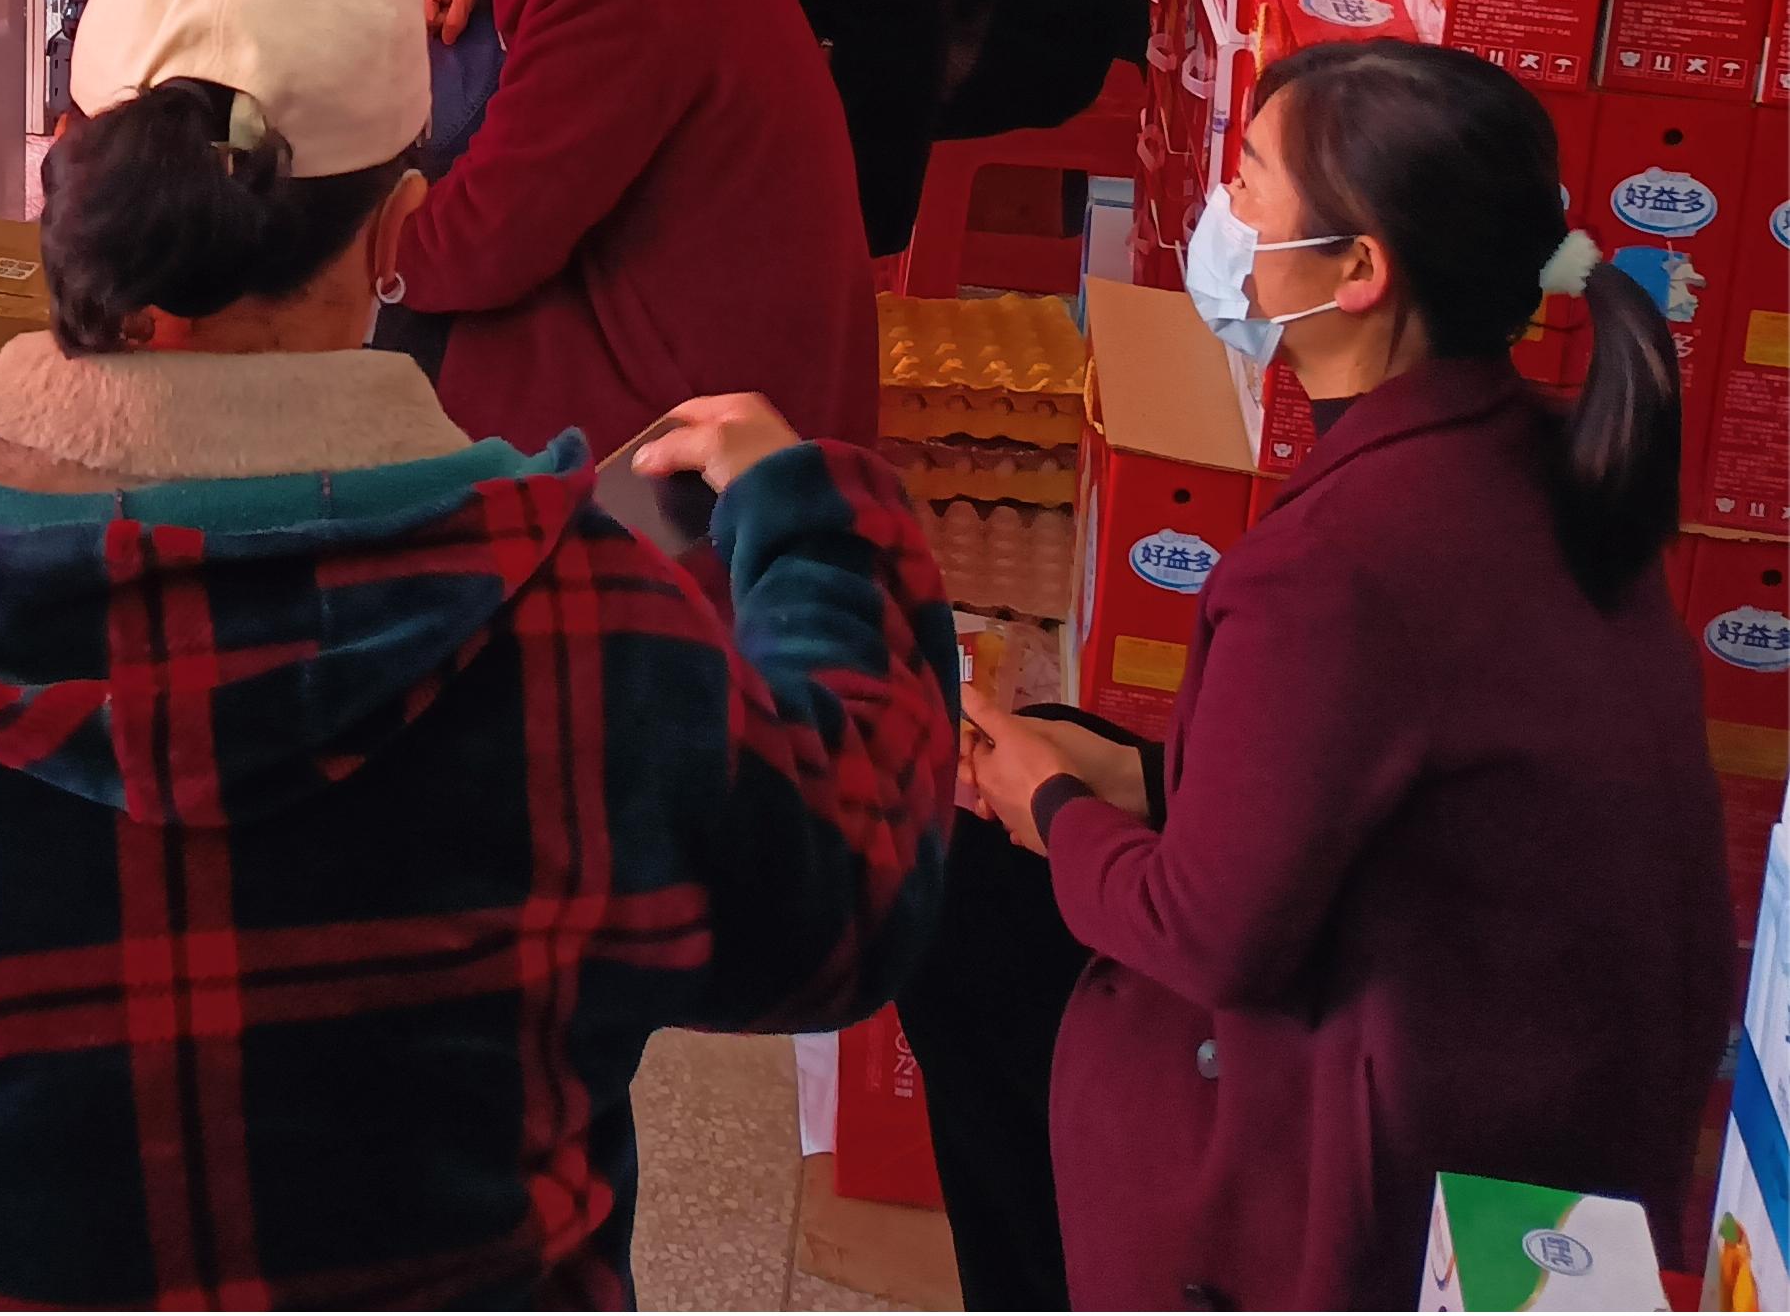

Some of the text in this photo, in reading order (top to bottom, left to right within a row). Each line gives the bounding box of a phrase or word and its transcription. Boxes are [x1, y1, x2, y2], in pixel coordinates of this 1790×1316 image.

[1623, 183, 1706, 214] 好益多
[1140, 543, 1213, 573] 好益多
